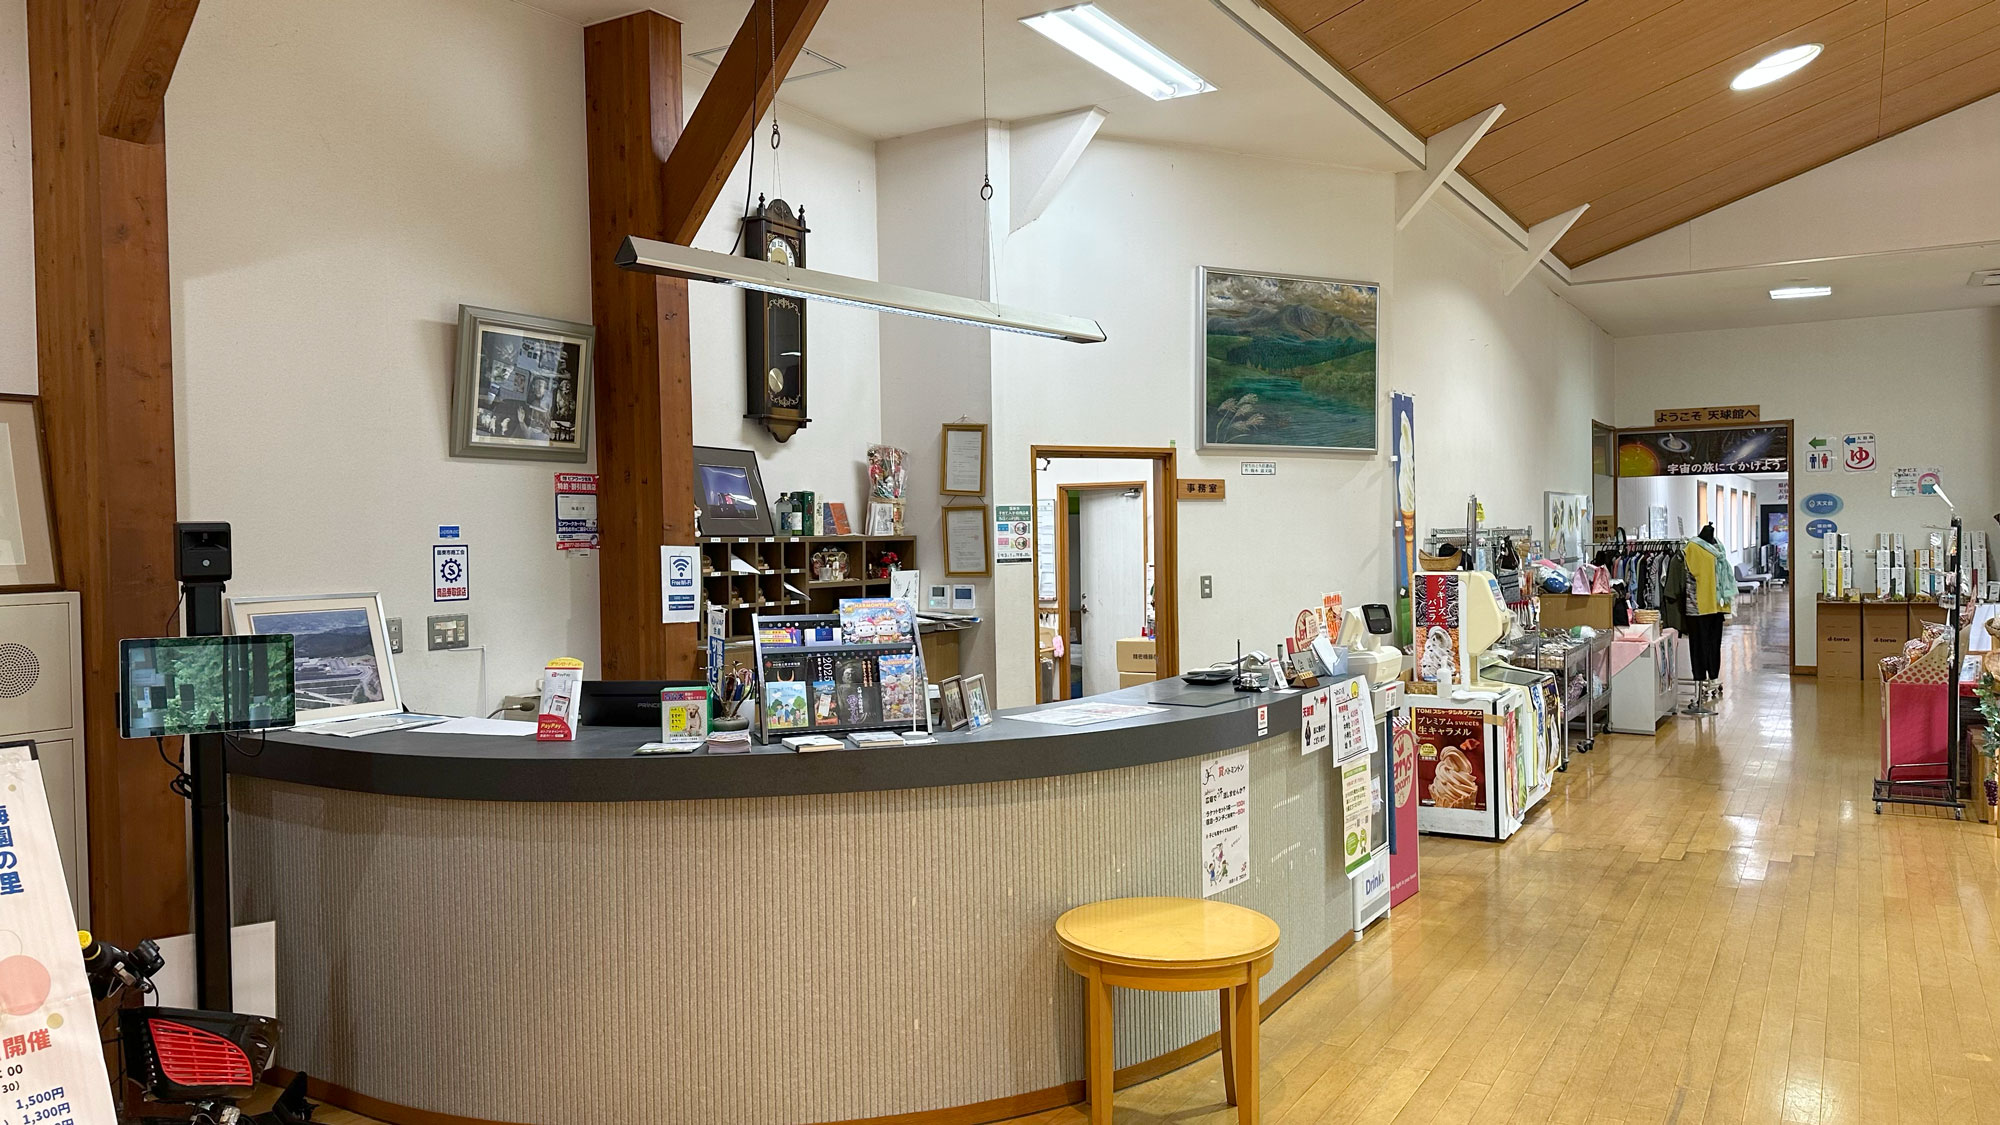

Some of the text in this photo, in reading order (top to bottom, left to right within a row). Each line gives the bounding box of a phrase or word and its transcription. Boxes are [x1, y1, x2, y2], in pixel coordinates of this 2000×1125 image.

[1656, 409, 1757, 423] ようこそ 天球館へ
[1849, 446, 1870, 465] ゆ
[1667, 460, 1781, 475] 宇宙の旅にでかけよう
[1186, 483, 1217, 493] 事務室
[1428, 598, 1437, 622] バニラ
[1417, 717, 1454, 726] プレミアム
[1418, 725, 1472, 736] 生キャラメル
[3, 1028, 52, 1060] 開催
[16, 1086, 65, 1110] 1,500円
[23, 1102, 71, 1125] 1,300円
